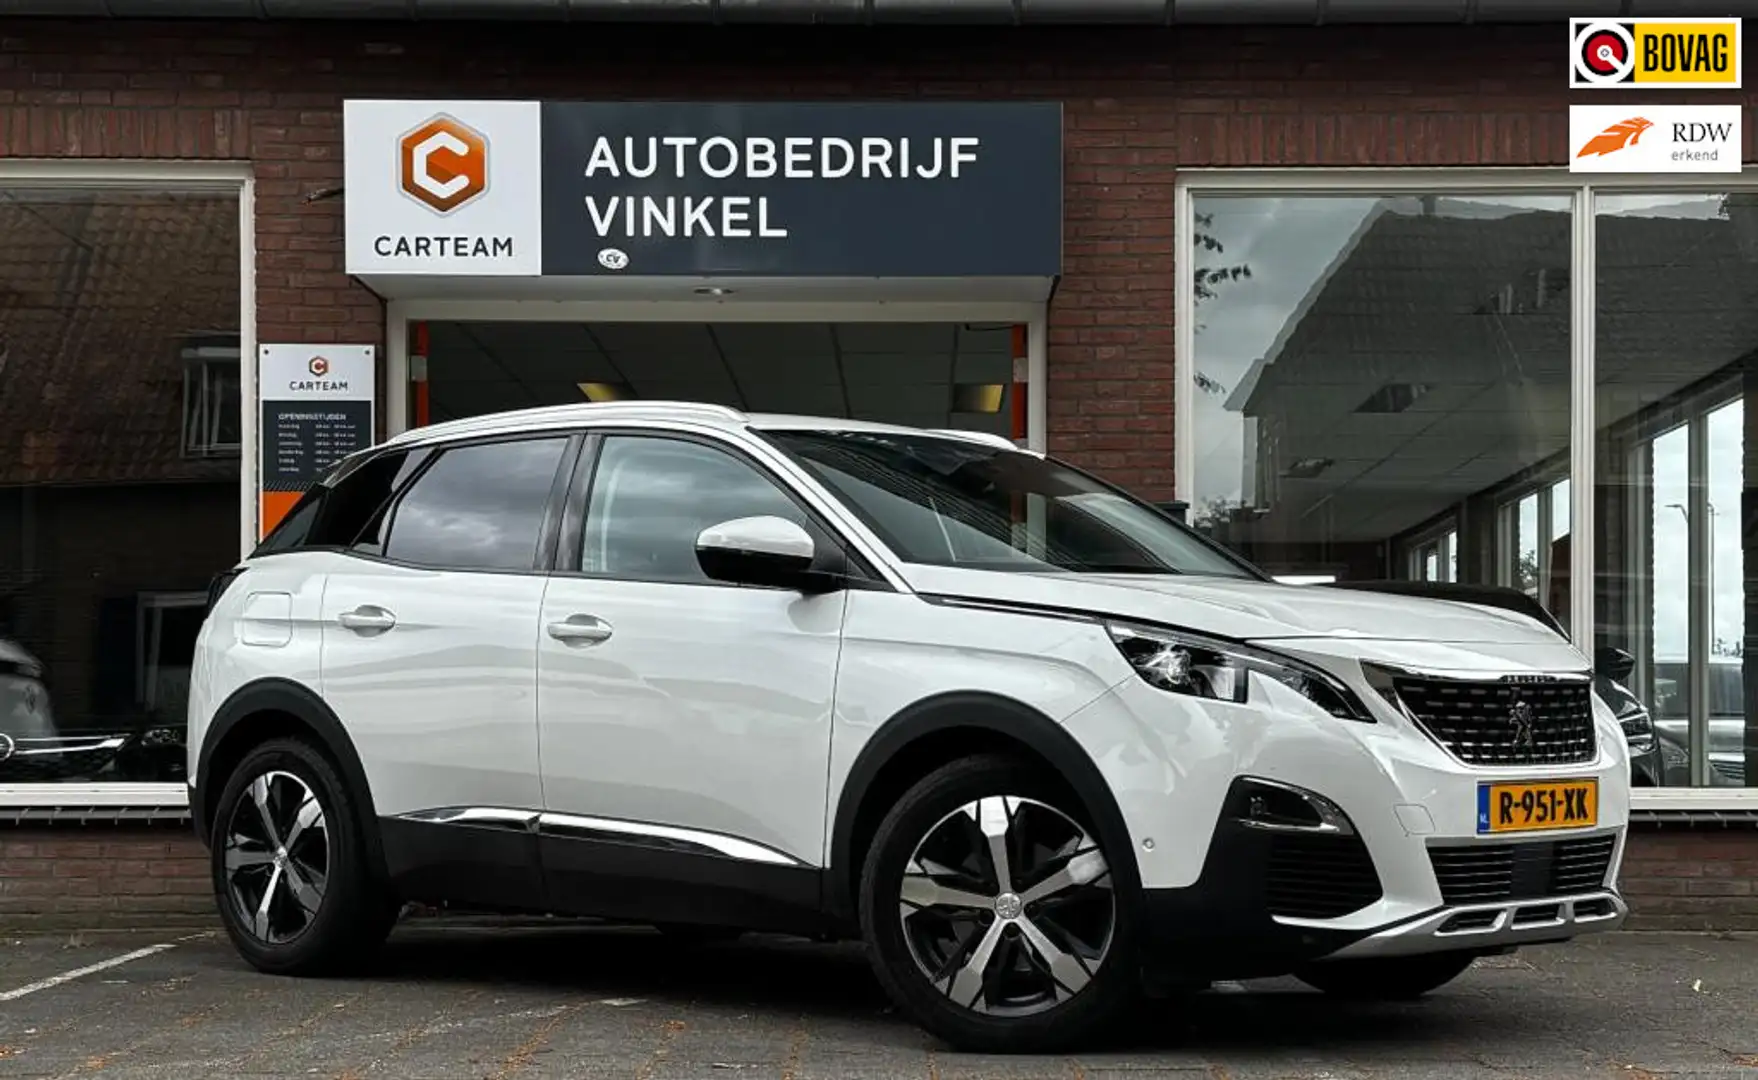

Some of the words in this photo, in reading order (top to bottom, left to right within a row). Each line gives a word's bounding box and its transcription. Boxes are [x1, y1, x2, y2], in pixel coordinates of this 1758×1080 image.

[584, 135, 980, 179] AUTOBEDRIJF
[584, 195, 788, 237] VINKEL
[374, 235, 513, 257] CARTEAM
[289, 381, 348, 391] CARTEAM
[1499, 787, 1589, 825] R-951-XK
